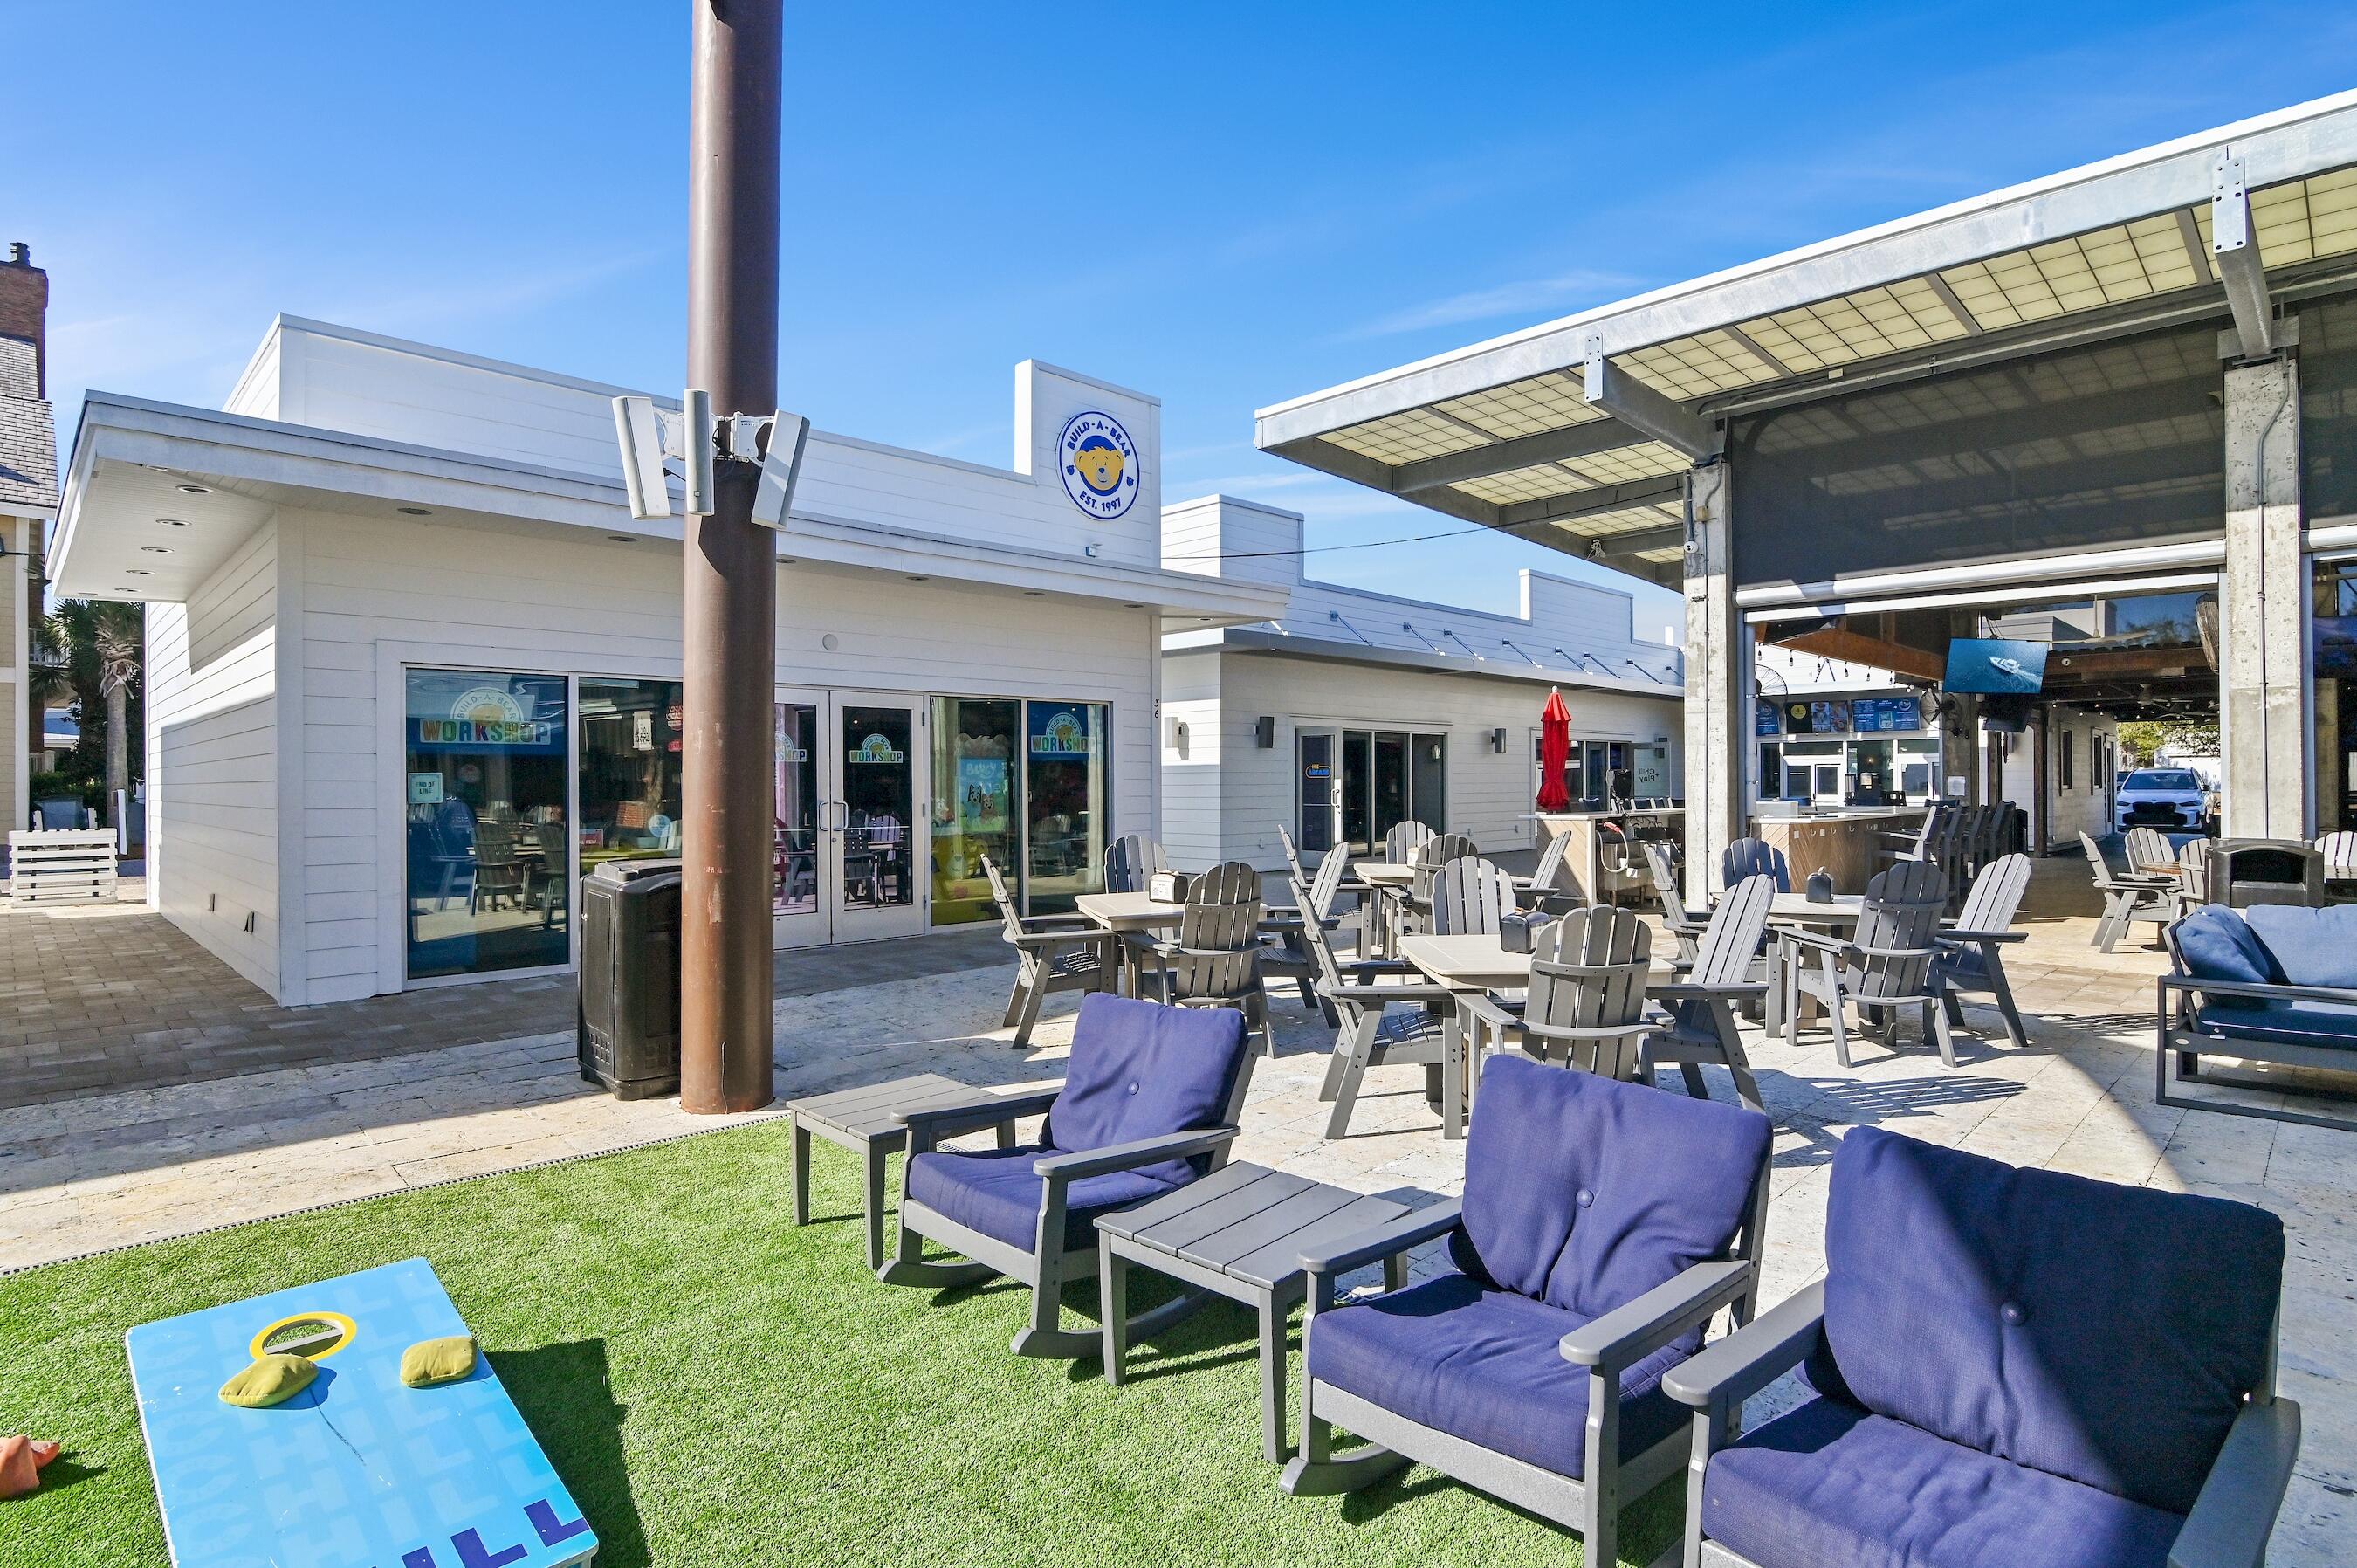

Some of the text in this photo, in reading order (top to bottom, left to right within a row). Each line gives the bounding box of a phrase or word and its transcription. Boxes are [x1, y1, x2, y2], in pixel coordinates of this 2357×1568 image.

[1067, 420, 1130, 458] BUILD-A-BEAR
[1080, 491, 1121, 512] EST. 1997
[423, 720, 550, 742] WORKSHOP
[1032, 736, 1096, 752] WORKSHO
[850, 751, 903, 762] WORKSHOP
